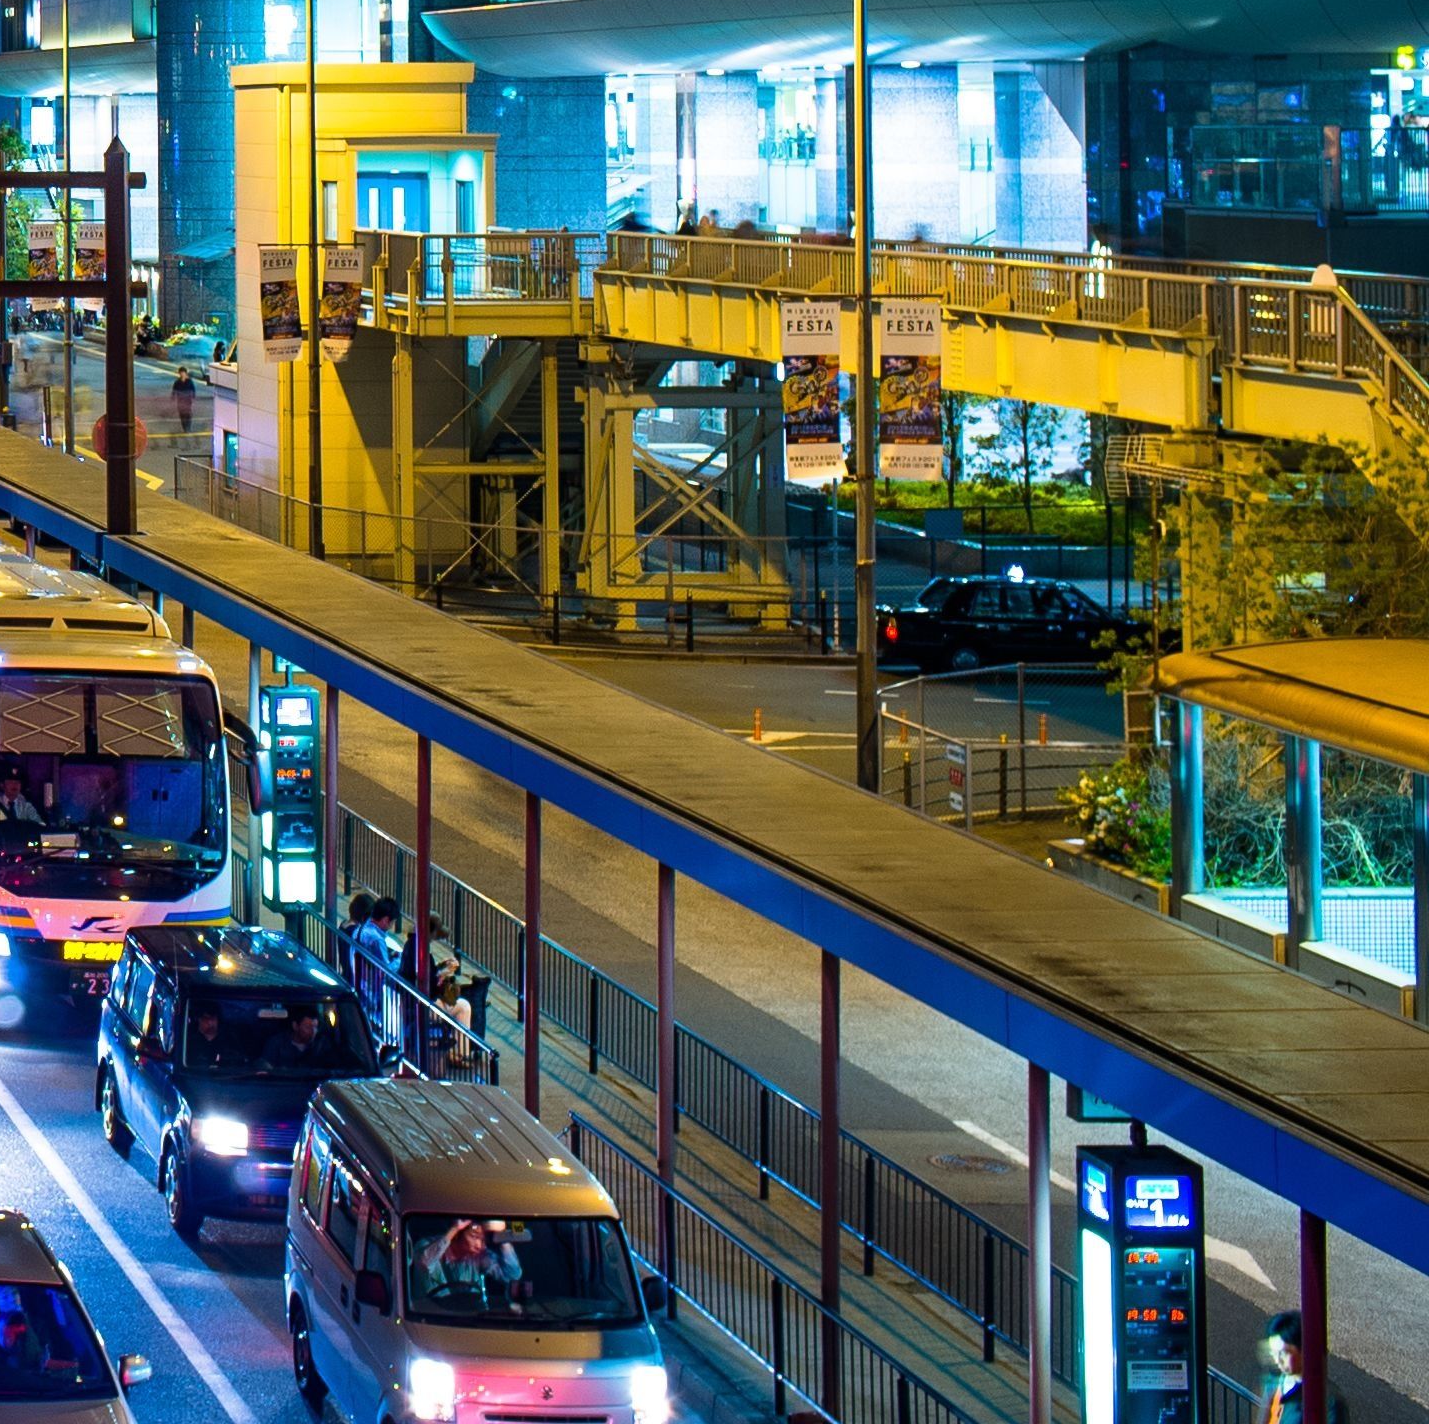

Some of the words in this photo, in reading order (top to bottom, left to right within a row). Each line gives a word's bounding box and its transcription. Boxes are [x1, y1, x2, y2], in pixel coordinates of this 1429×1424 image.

[262, 258, 293, 268] FESTA
[327, 259, 359, 267] FESTA
[786, 319, 834, 332] FESTA
[886, 319, 935, 332] FESTA
